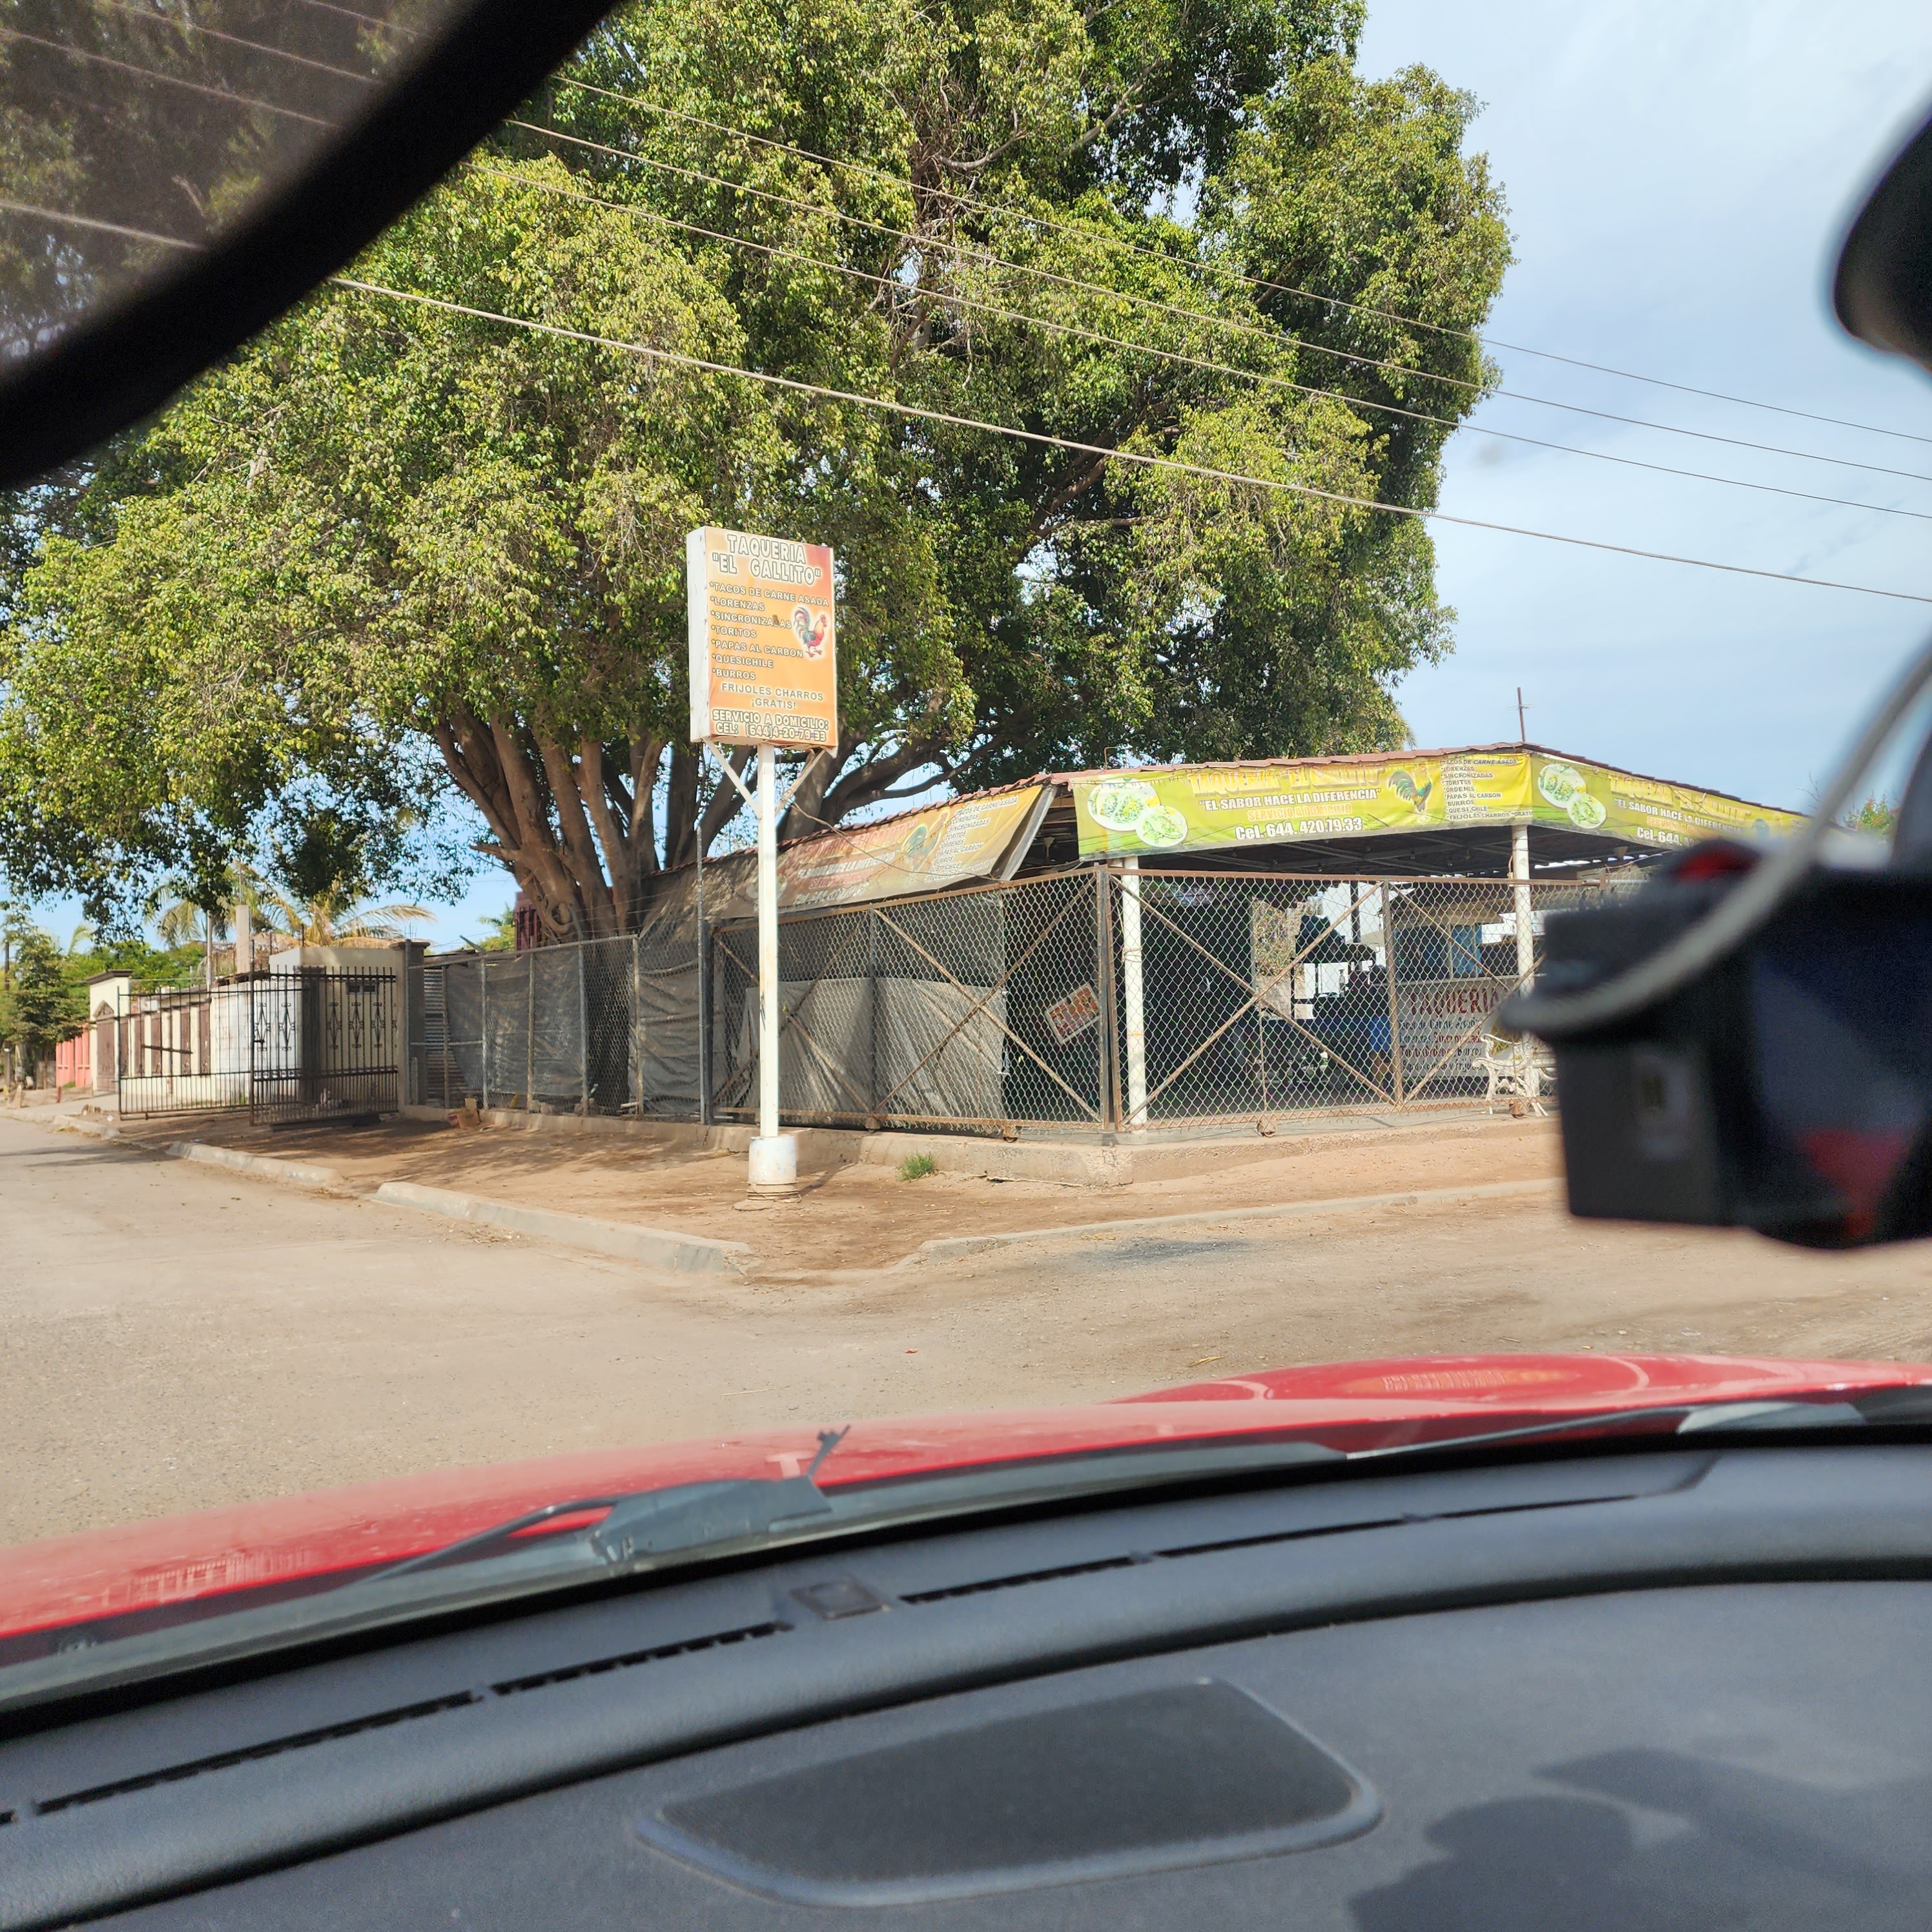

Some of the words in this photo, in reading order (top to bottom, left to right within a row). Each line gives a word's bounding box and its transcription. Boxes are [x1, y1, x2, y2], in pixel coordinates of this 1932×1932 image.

[727, 534, 806, 564] TAQUERIA
[712, 552, 737, 574] "EL
[750, 559, 821, 585] GALLITO"
[749, 588, 761, 597] DE
[765, 589, 796, 602] CARNE
[798, 595, 829, 606] ASADA
[710, 611, 792, 629] SINCRONIZAAS
[749, 644, 761, 653] AL
[764, 645, 803, 658] CARBON
[722, 683, 772, 695] FRIJOLES
[776, 688, 823, 701] CHARROS
[752, 698, 796, 710] ¡GRATIS!
[712, 709, 761, 724] SERVICIO
[764, 714, 772, 725] A
[776, 715, 829, 730] DOMICILIO:
[716, 722, 739, 735] CEL:
[1220, 797, 1262, 810] SABOR
[1264, 795, 1295, 807] HACE
[1297, 793, 1311, 804] LA
[1248, 807, 1293, 822] SERVICIO
[1294, 807, 1303, 817] A
[1304, 803, 1353, 817] DOMICILIO
[1629, 801, 1659, 816] SABOR
[1660, 808, 1683, 821] HACE
[1684, 815, 1694, 824] LA
[1235, 825, 1264, 840] Cel.
[1266, 822, 1298, 838] 644.
[1636, 826, 1657, 841] Cel.
